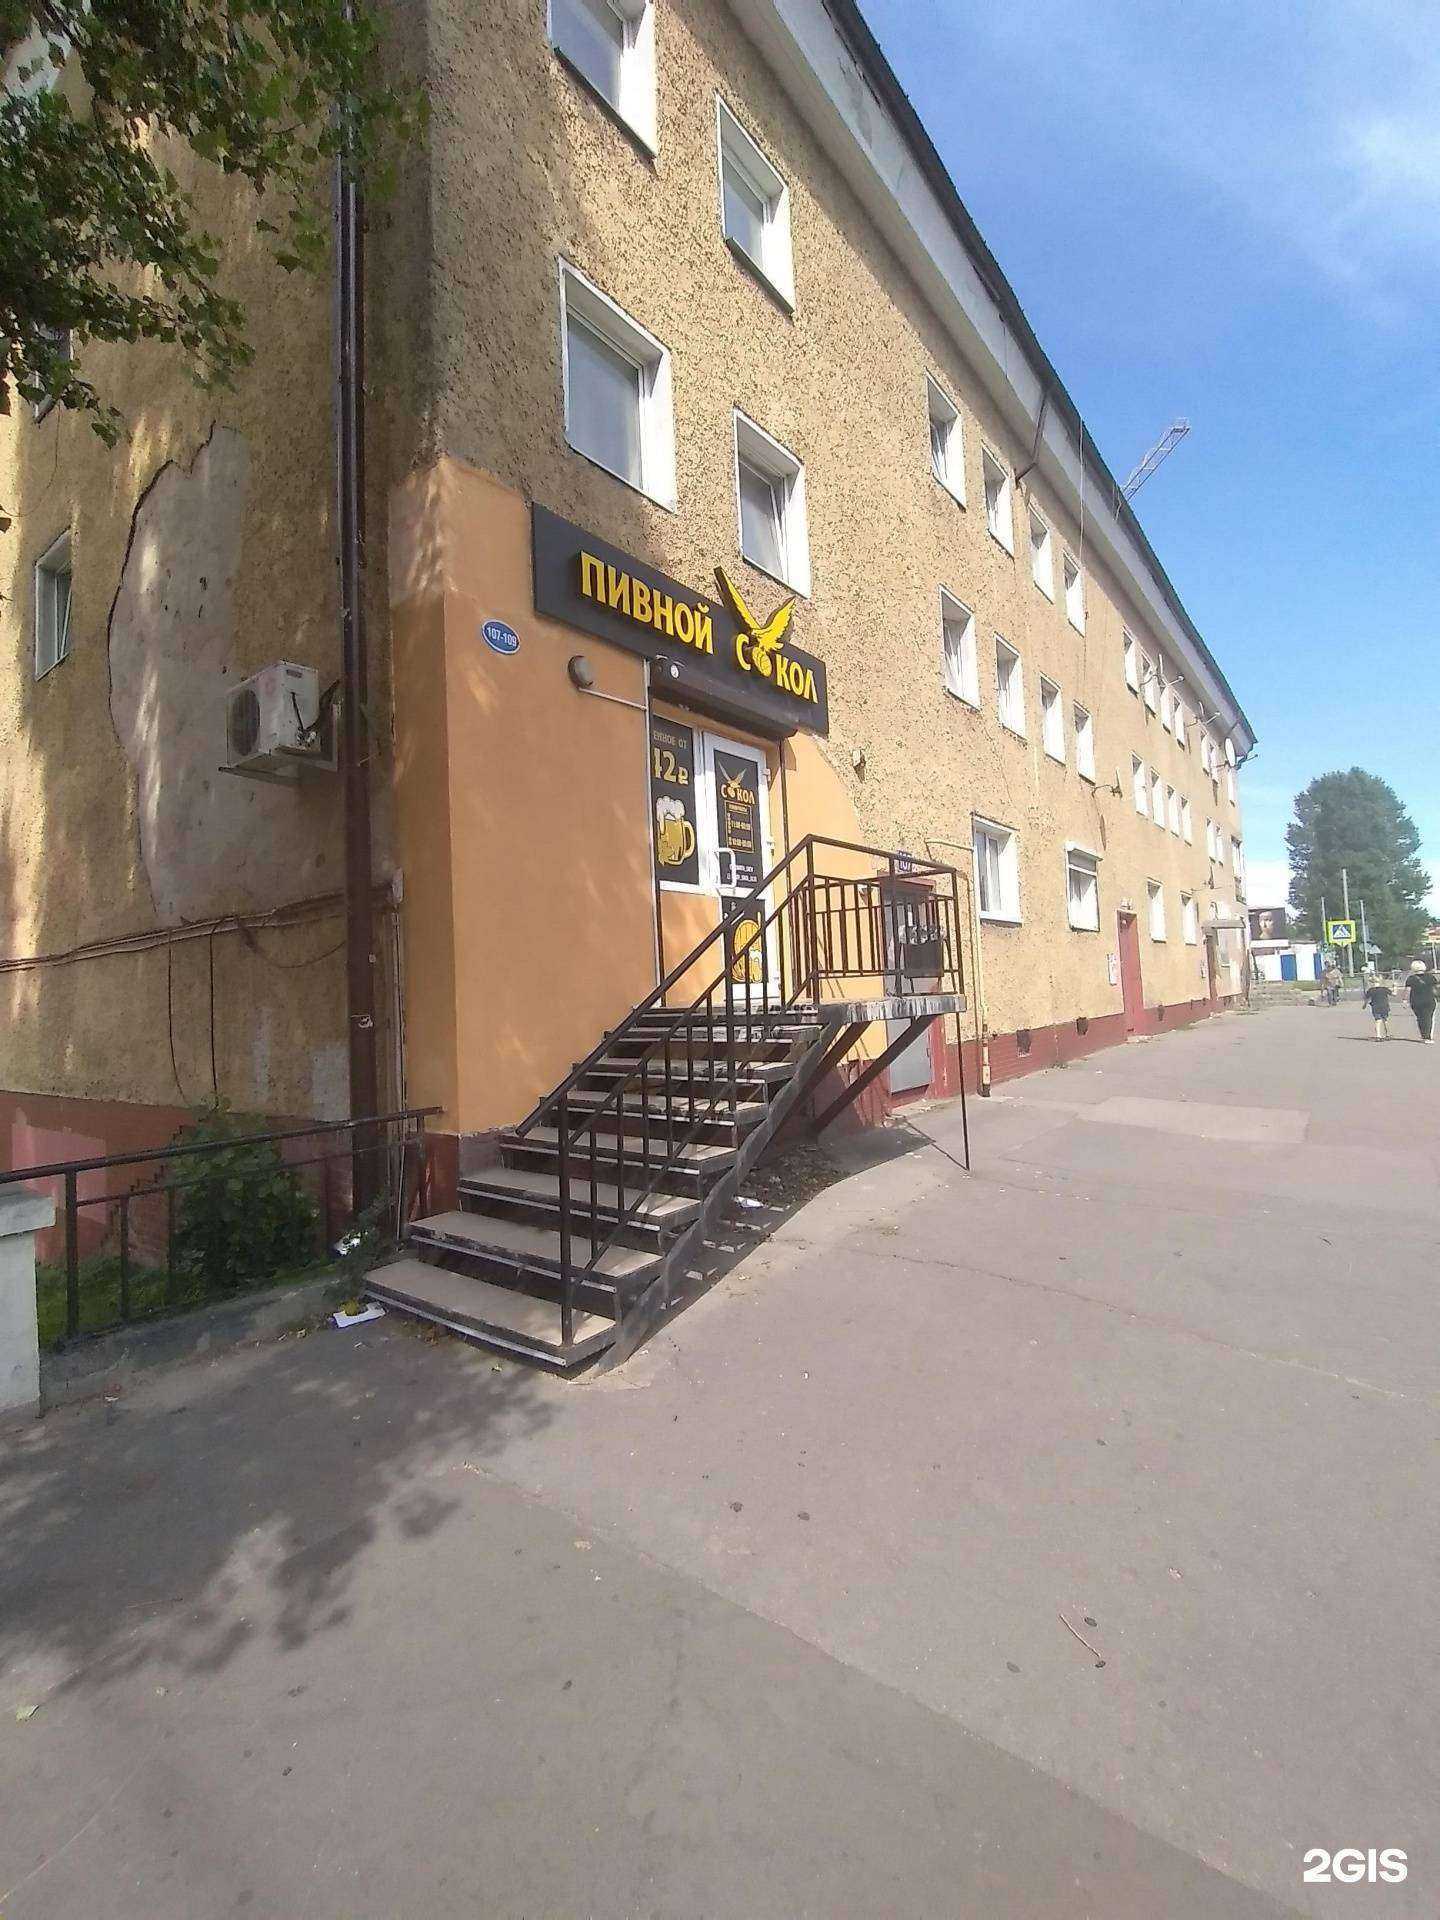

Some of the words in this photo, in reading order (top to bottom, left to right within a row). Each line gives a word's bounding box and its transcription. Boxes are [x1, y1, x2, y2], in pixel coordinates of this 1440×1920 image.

[580, 550, 714, 655] ПИВНОЙ
[486, 626, 517, 647] 107-109
[653, 729, 676, 746] ЕННОЕ
